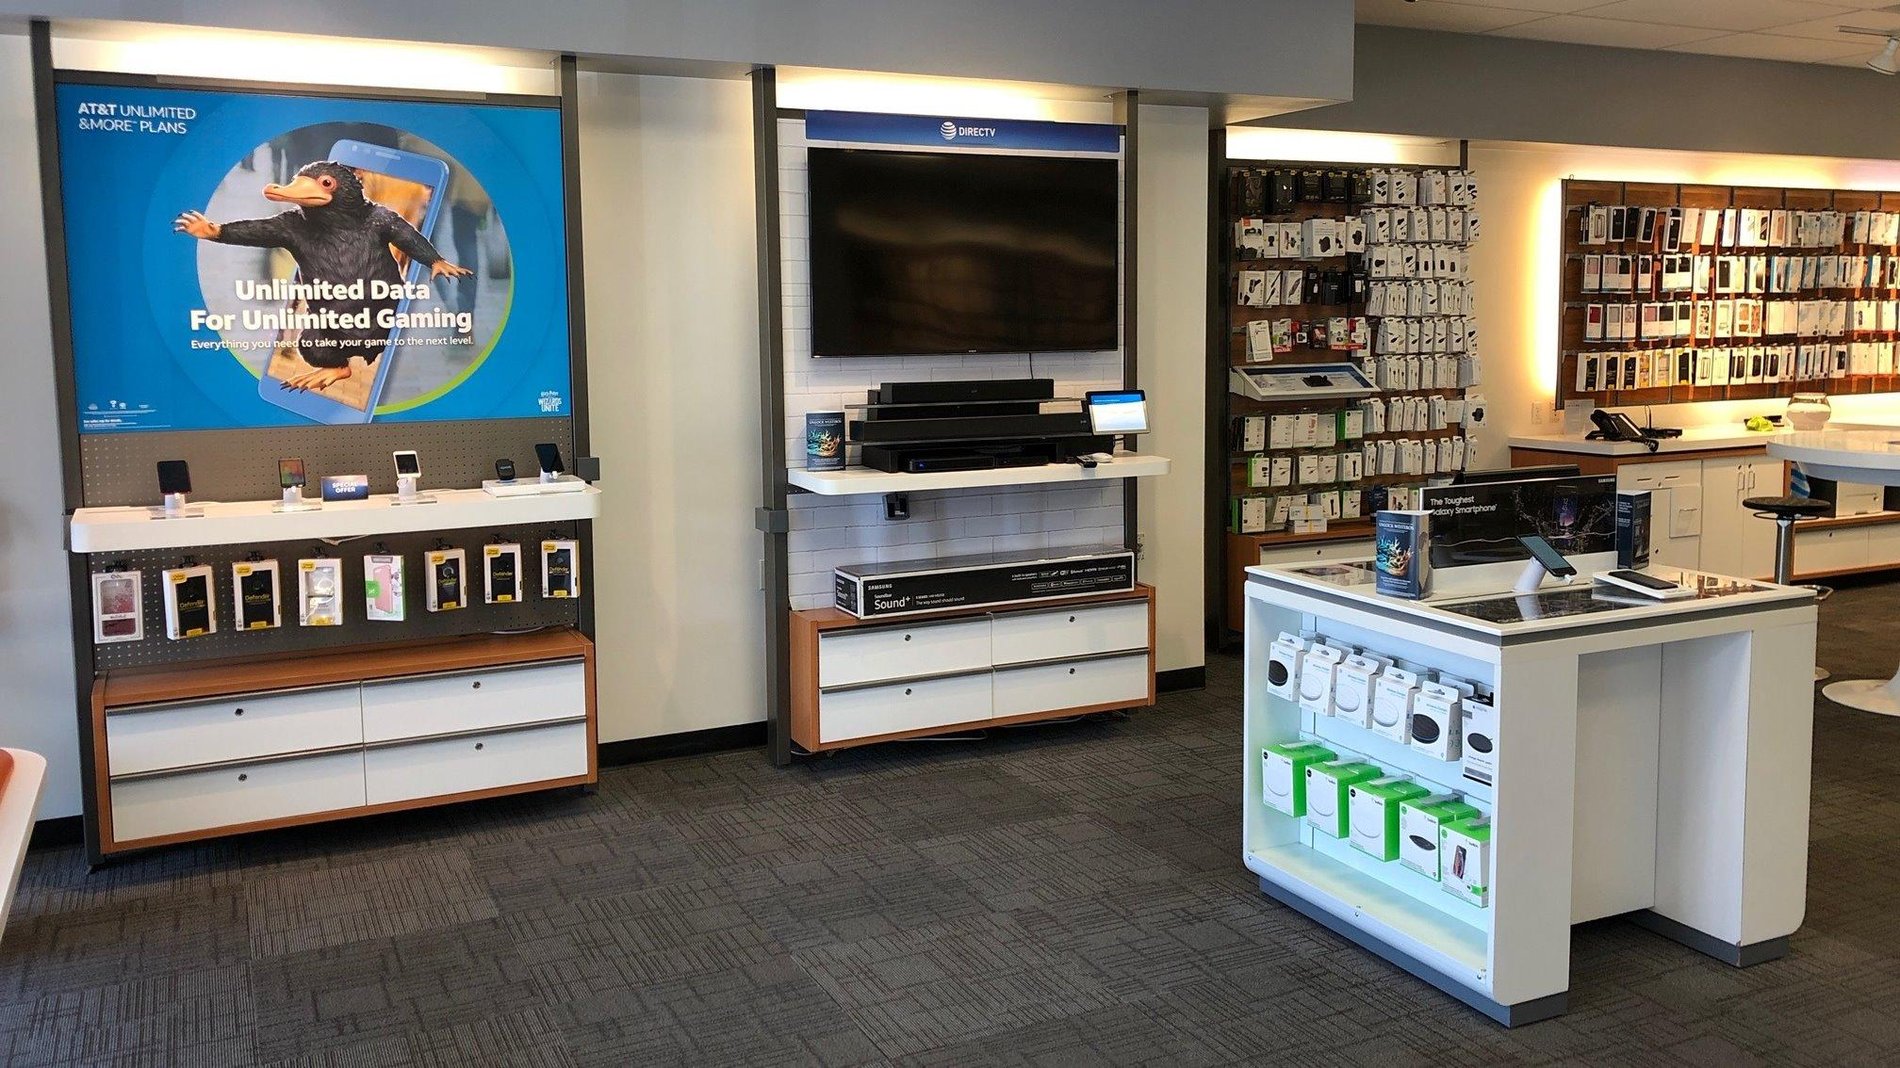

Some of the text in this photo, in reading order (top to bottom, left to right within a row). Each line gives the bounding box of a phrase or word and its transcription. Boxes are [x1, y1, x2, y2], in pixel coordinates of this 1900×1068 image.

[78, 102, 197, 120] AT&T UNLIMITED
[140, 120, 188, 134] PLANS
[958, 126, 996, 137] DIRECTV
[235, 278, 430, 300] Unlimited Data
[190, 306, 472, 333] For Unlimited Gaming
[191, 336, 474, 351] Everything you need to take your game to the next level.
[335, 486, 356, 494] OFFER
[1430, 495, 1475, 506] The Toughest
